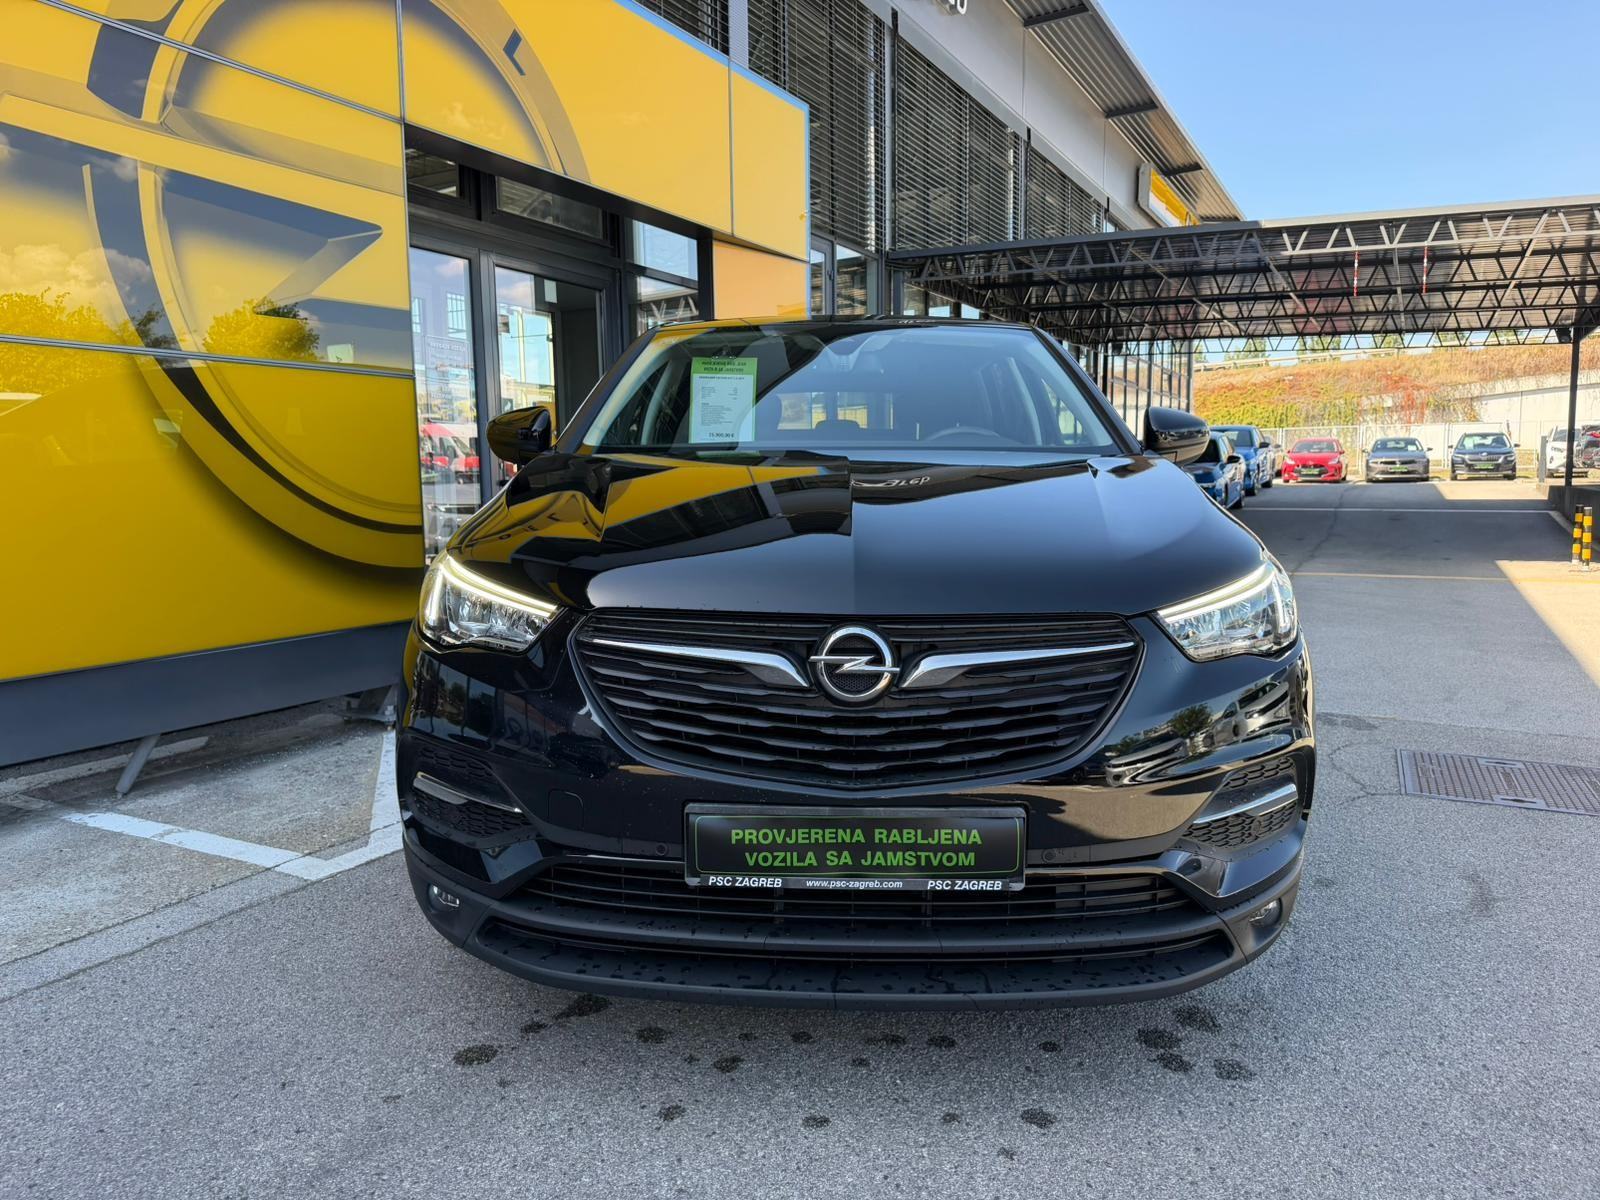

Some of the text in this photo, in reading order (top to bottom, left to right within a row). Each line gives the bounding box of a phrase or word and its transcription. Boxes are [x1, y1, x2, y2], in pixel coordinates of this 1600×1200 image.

[731, 828, 982, 845] PROVJERENA RABLJENA
[745, 851, 975, 866] VOZILA SA JAMSTVOM
[708, 876, 782, 888] PSC ZAGREB
[806, 880, 903, 889] www.psc-zagreb.com
[927, 880, 1002, 891] PSC ZAGREB
